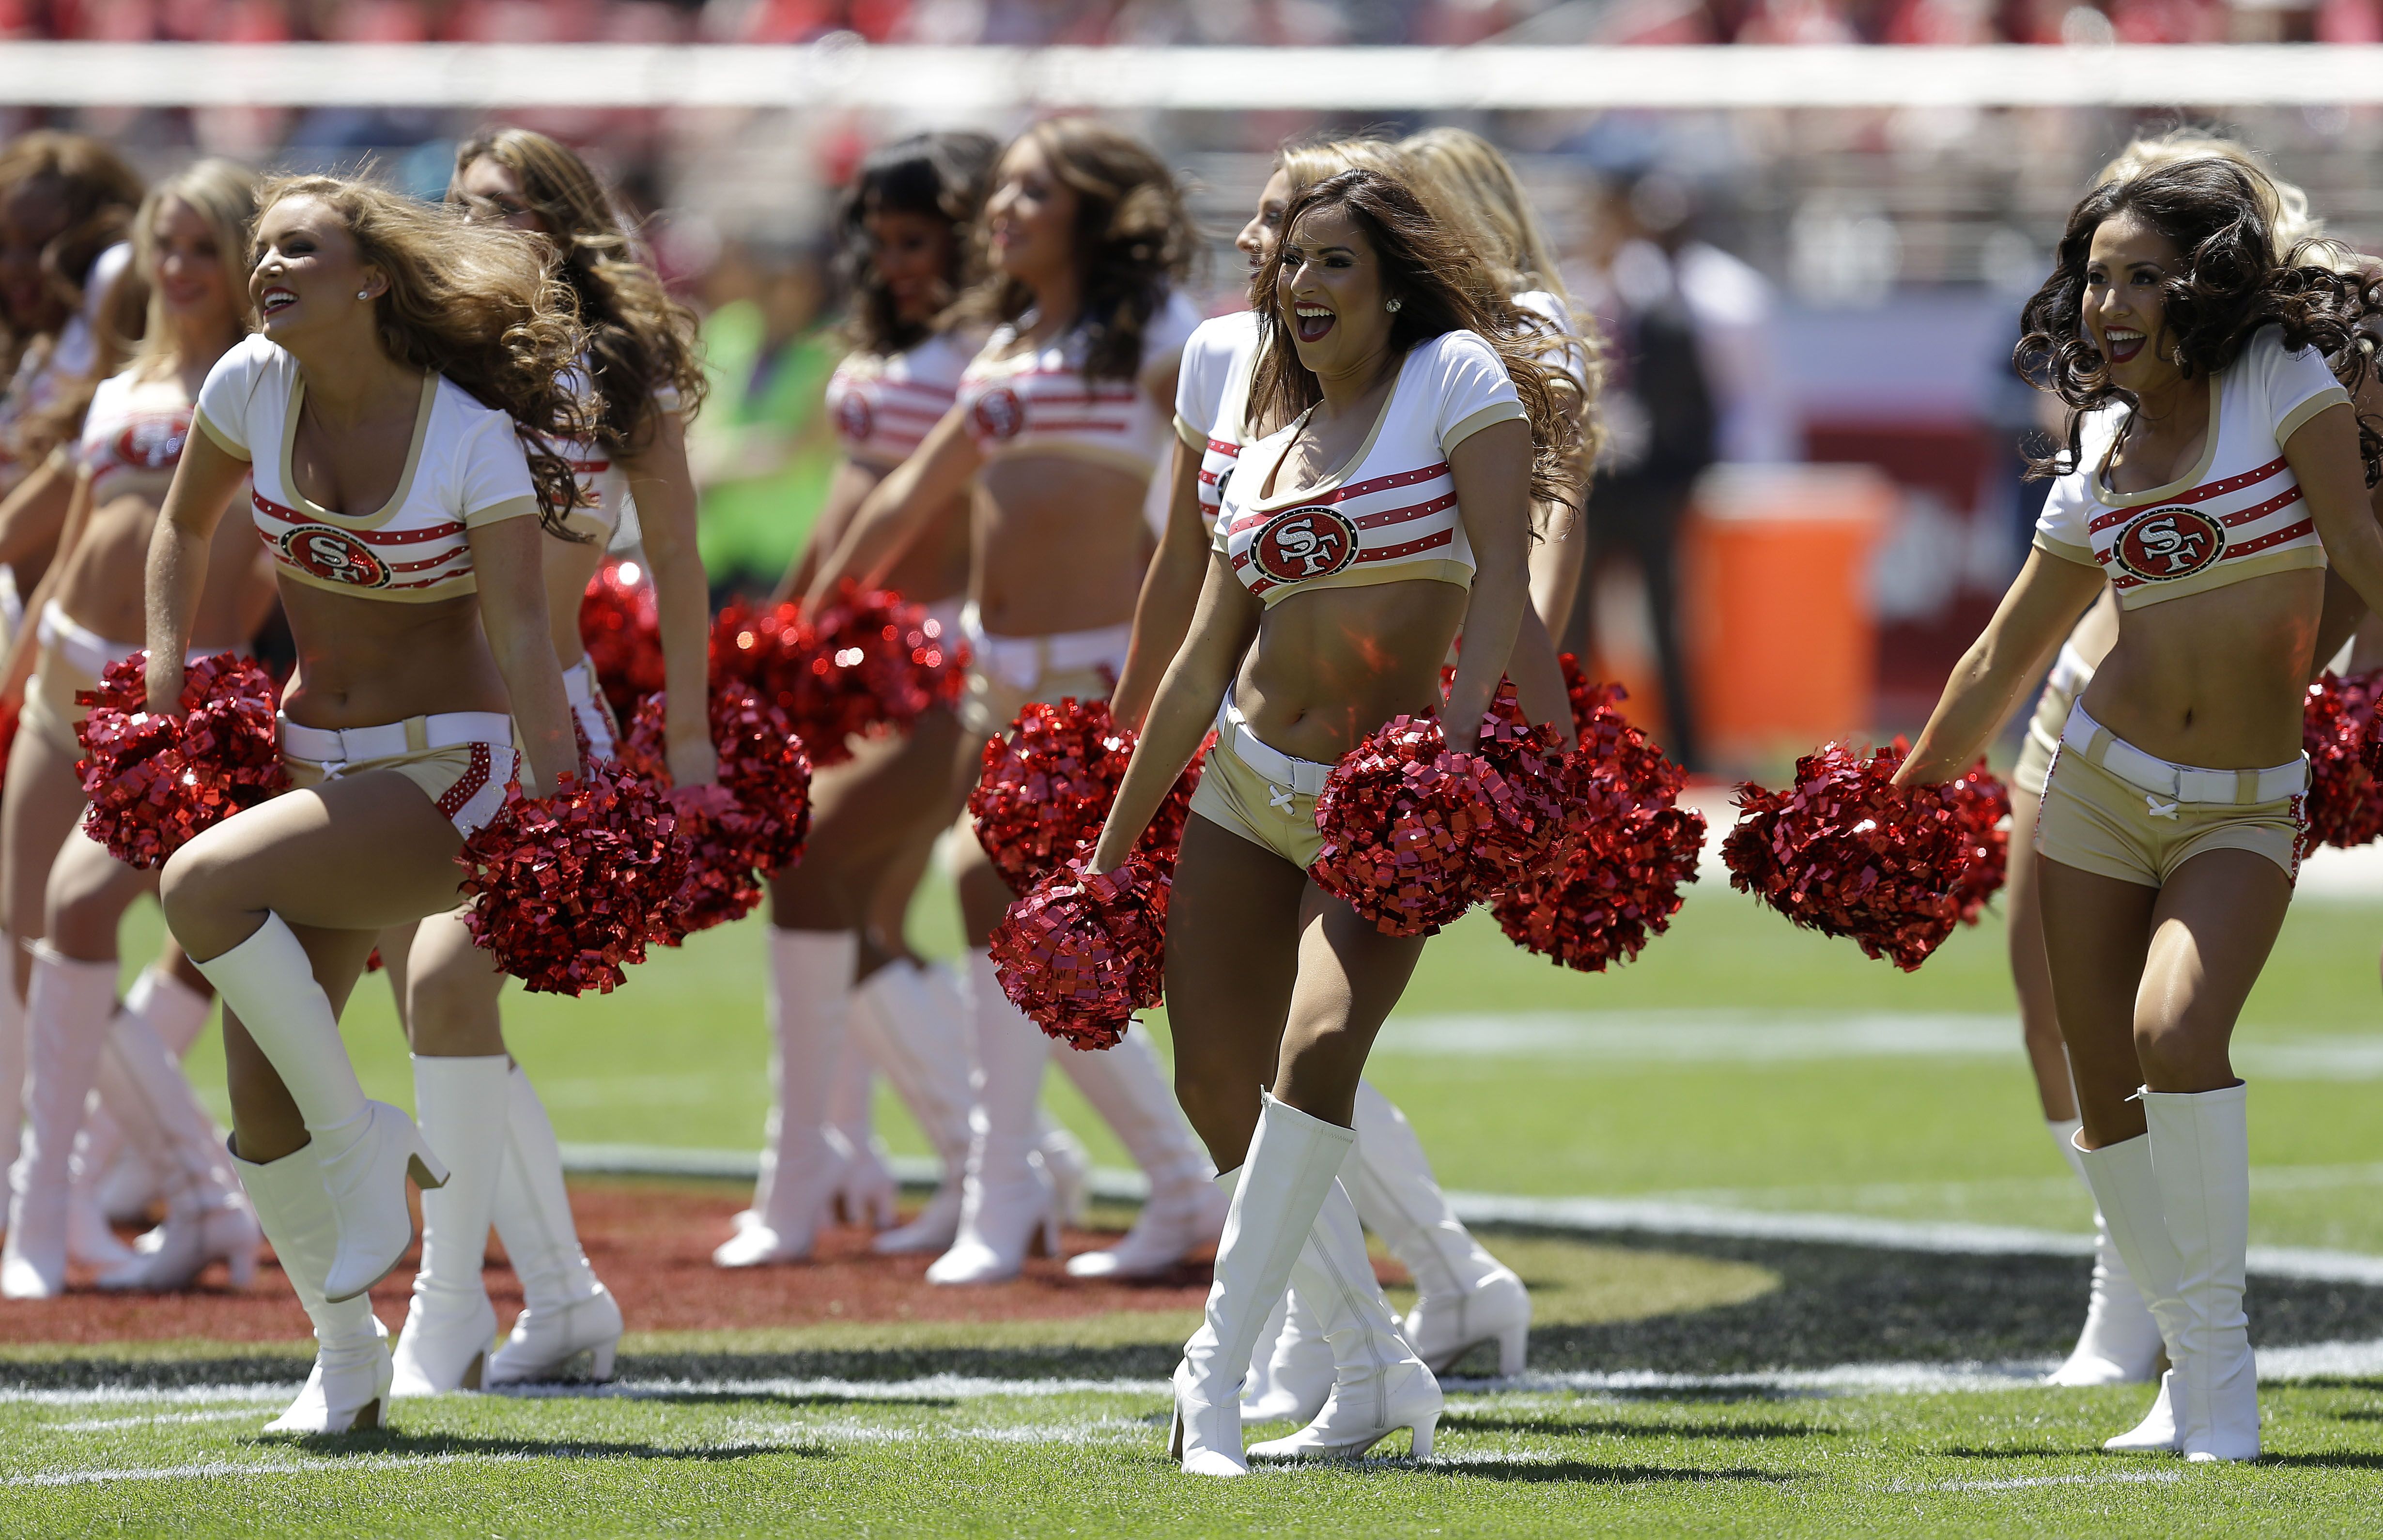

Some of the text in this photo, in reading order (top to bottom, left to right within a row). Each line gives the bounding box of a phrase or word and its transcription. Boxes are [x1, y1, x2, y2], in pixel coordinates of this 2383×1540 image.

[309, 536, 370, 583] SF
[1276, 518, 1338, 576] SF
[2139, 517, 2205, 573] SF
